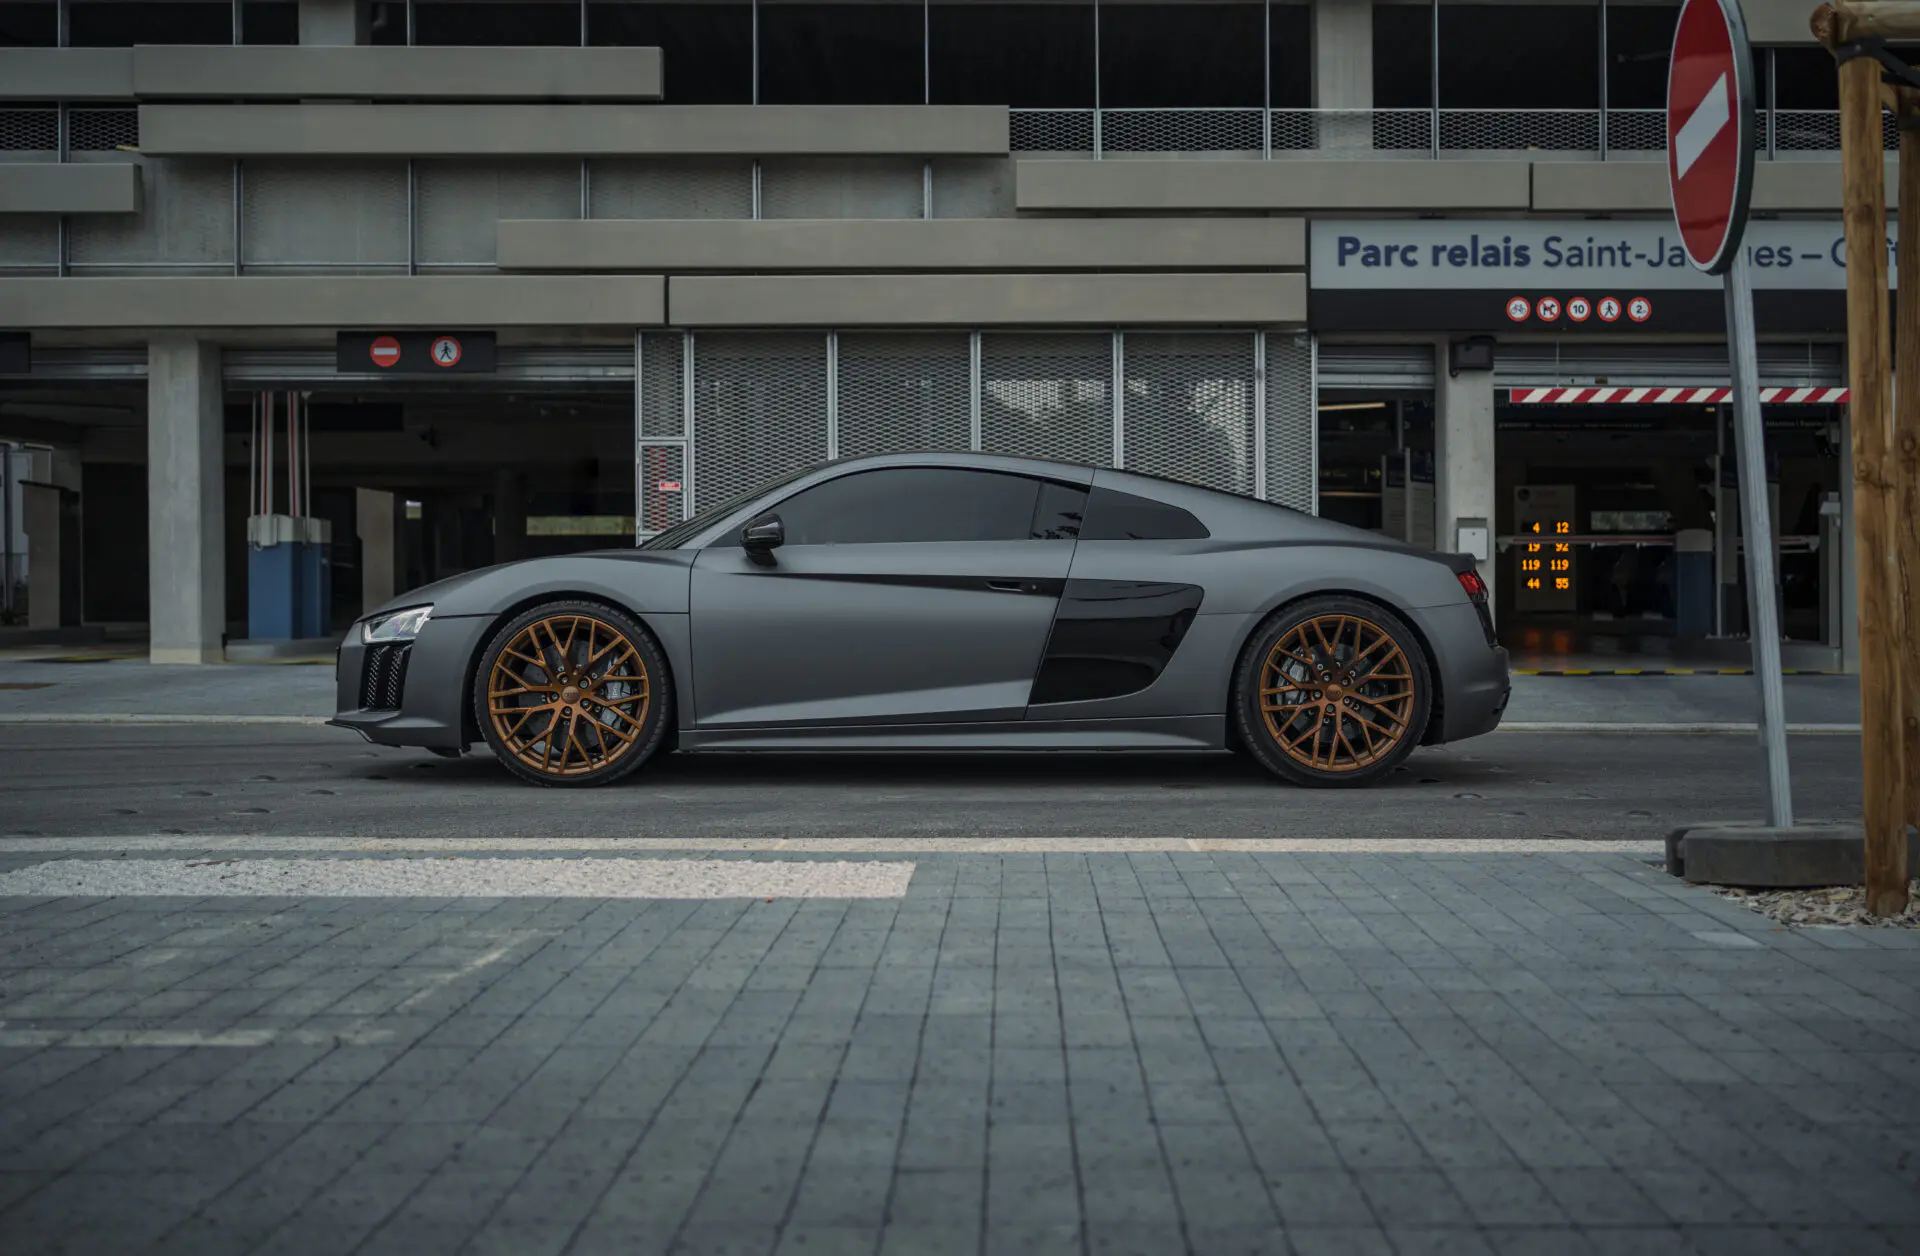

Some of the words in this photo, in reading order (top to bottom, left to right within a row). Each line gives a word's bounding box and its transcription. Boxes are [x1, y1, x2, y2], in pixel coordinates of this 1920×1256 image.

[1337, 235, 1419, 268] Parc
[1432, 234, 1531, 268] relais
[1542, 235, 1794, 268] Saint-Jaes
[1573, 304, 1585, 314] 10
[1533, 521, 1540, 533] 4
[1556, 521, 1569, 533] 12
[1522, 559, 1541, 571] 119
[1550, 559, 1569, 571] 119
[1527, 577, 1540, 589] 44
[1555, 577, 1569, 589] 55
